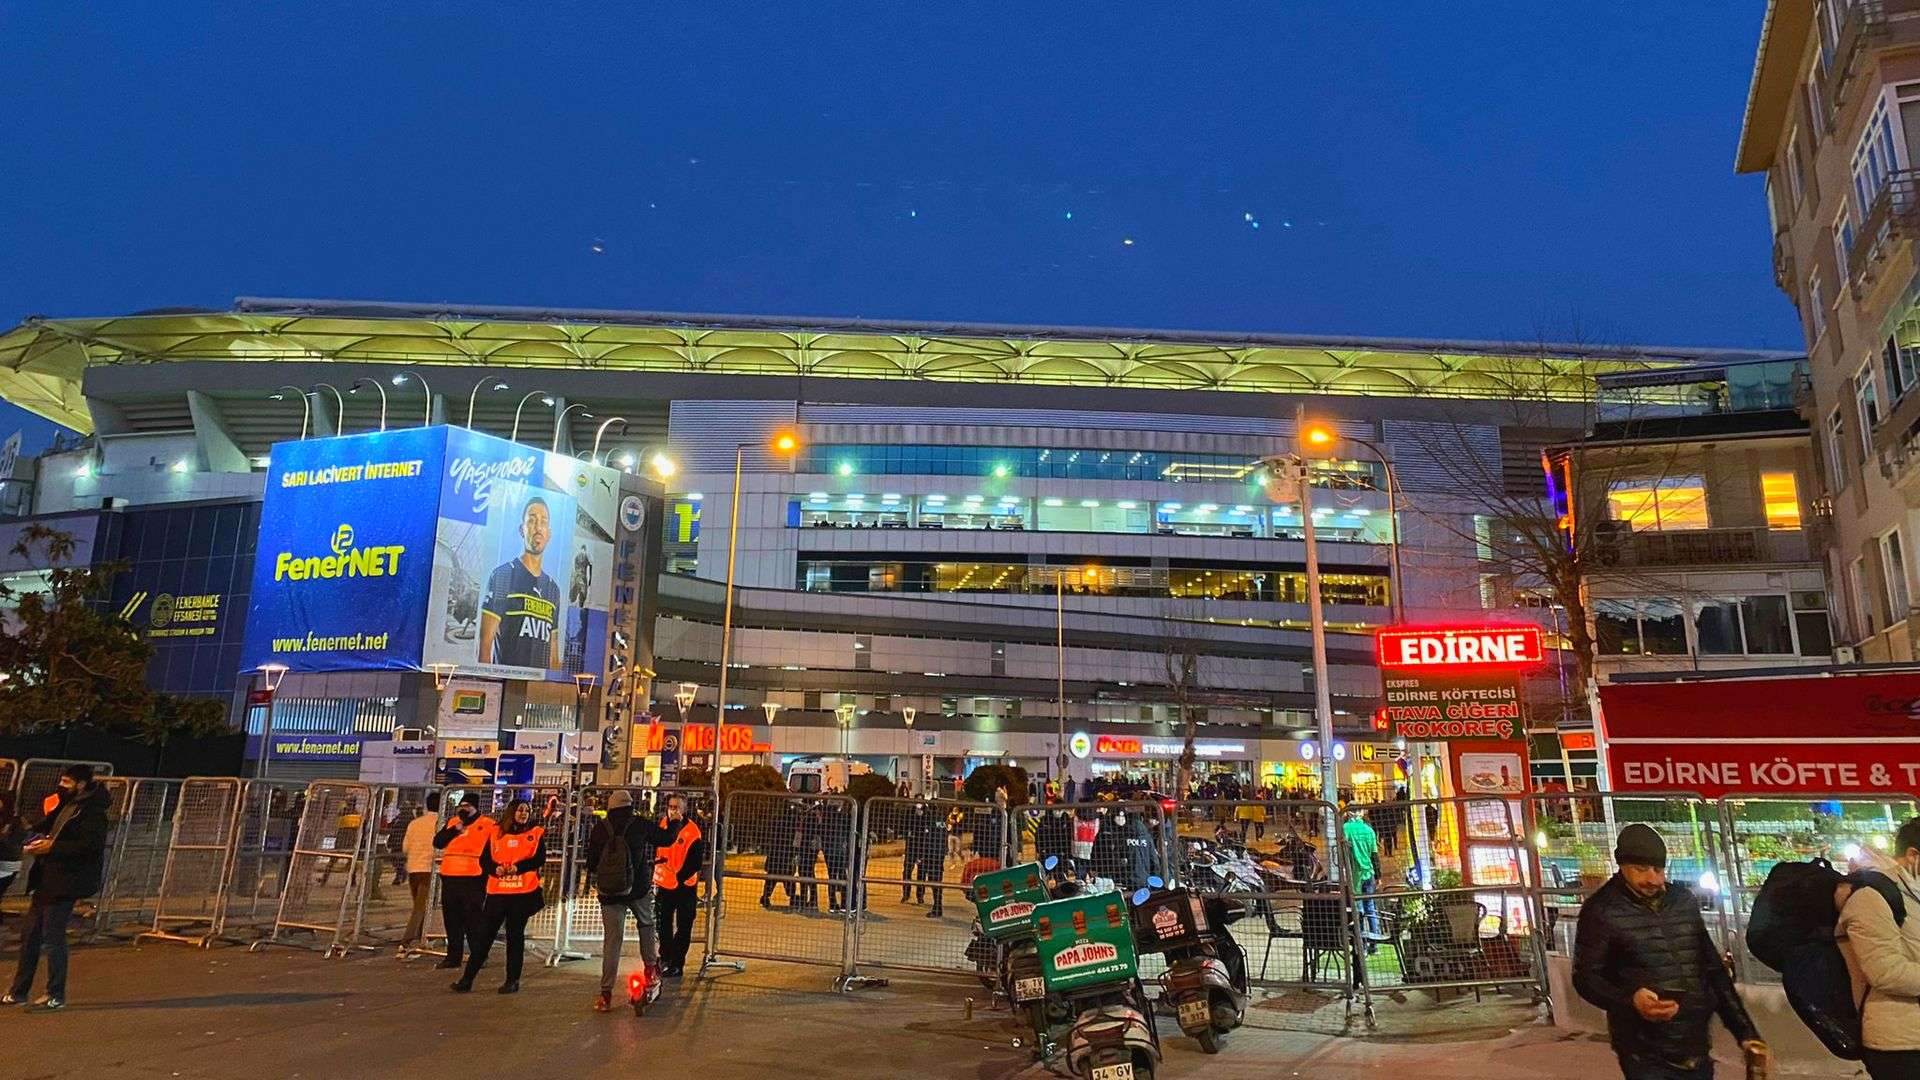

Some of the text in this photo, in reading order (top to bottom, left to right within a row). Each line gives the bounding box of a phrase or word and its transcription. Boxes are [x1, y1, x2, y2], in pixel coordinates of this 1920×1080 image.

[282, 460, 424, 488] SARI LACİVERT İNTERNET
[274, 545, 405, 582] FenerNET
[519, 616, 552, 642] AVIS
[272, 631, 388, 652] www.fenernet.net
[1400, 632, 1528, 664] EDİRNE
[1387, 686, 1516, 702] EDİRNE KÖFTECİSİ
[1388, 705, 1443, 720] TAVA
[1446, 701, 1519, 719] CİĞERİ
[1396, 719, 1513, 739] KOKOREÇ
[276, 738, 360, 755] www.fenernet.net
[1624, 757, 1742, 785] EDİRNE
[1750, 757, 1861, 786] KÖFTE
[1869, 763, 1893, 786] &
[991, 909, 1010, 921] PAPA
[1056, 946, 1115, 967] PAPA JOHN'S
[1094, 1065, 1131, 1079] 34 GV
